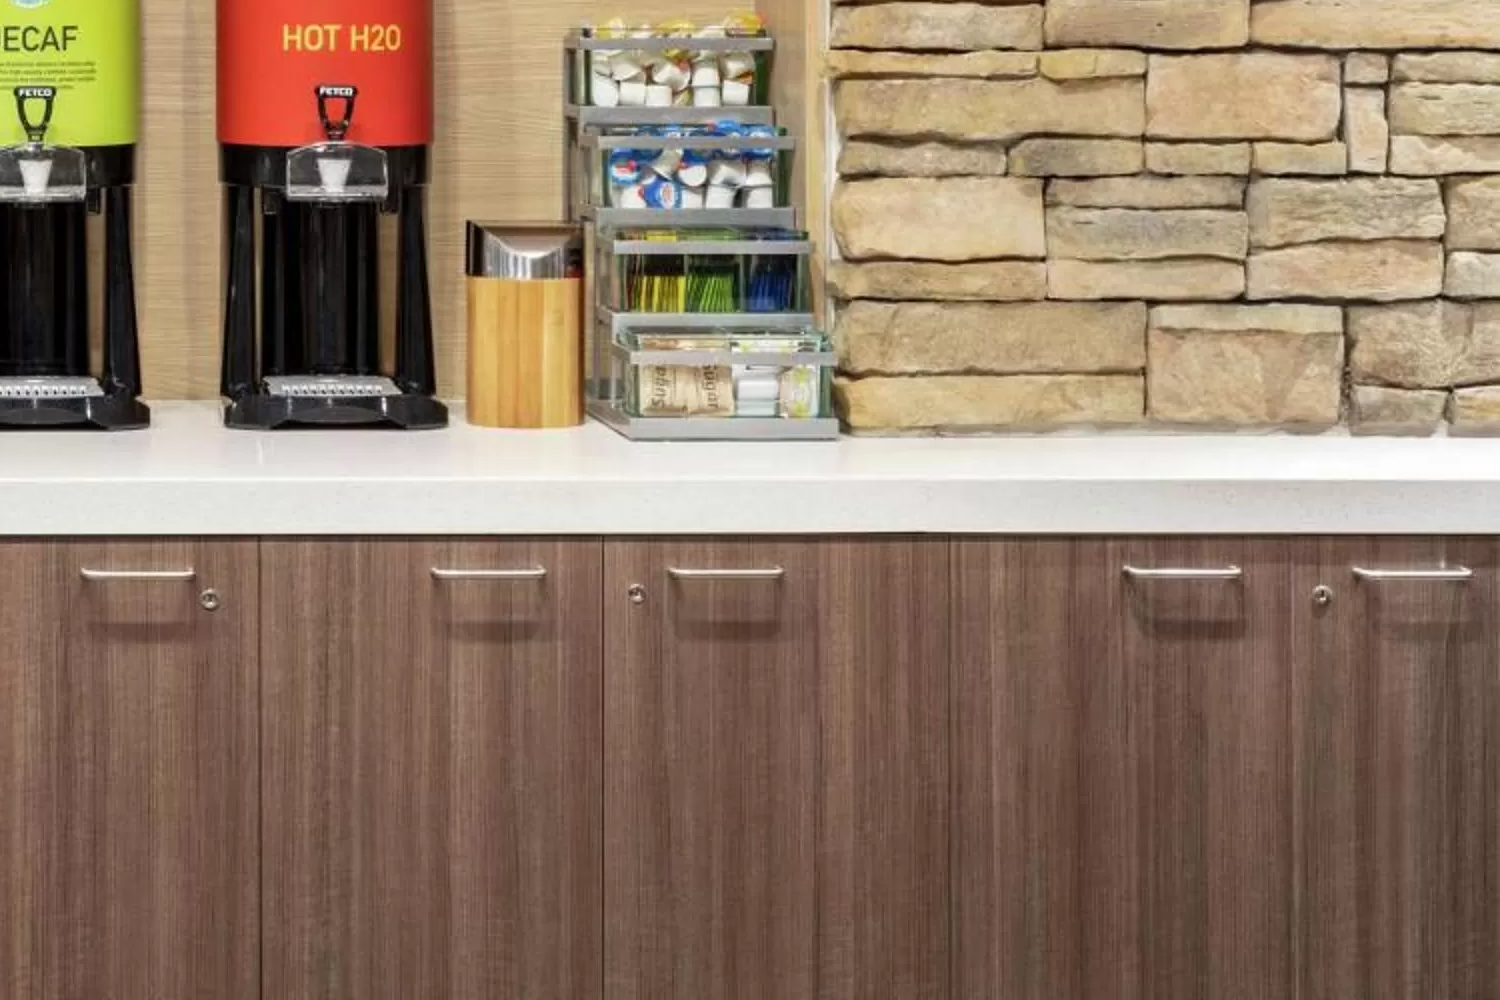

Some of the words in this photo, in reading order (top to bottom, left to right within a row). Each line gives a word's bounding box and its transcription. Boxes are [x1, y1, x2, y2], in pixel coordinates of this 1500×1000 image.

[282, 23, 342, 52] HOT
[18, 87, 53, 97] FETCO
[651, 366, 669, 409] Suga
